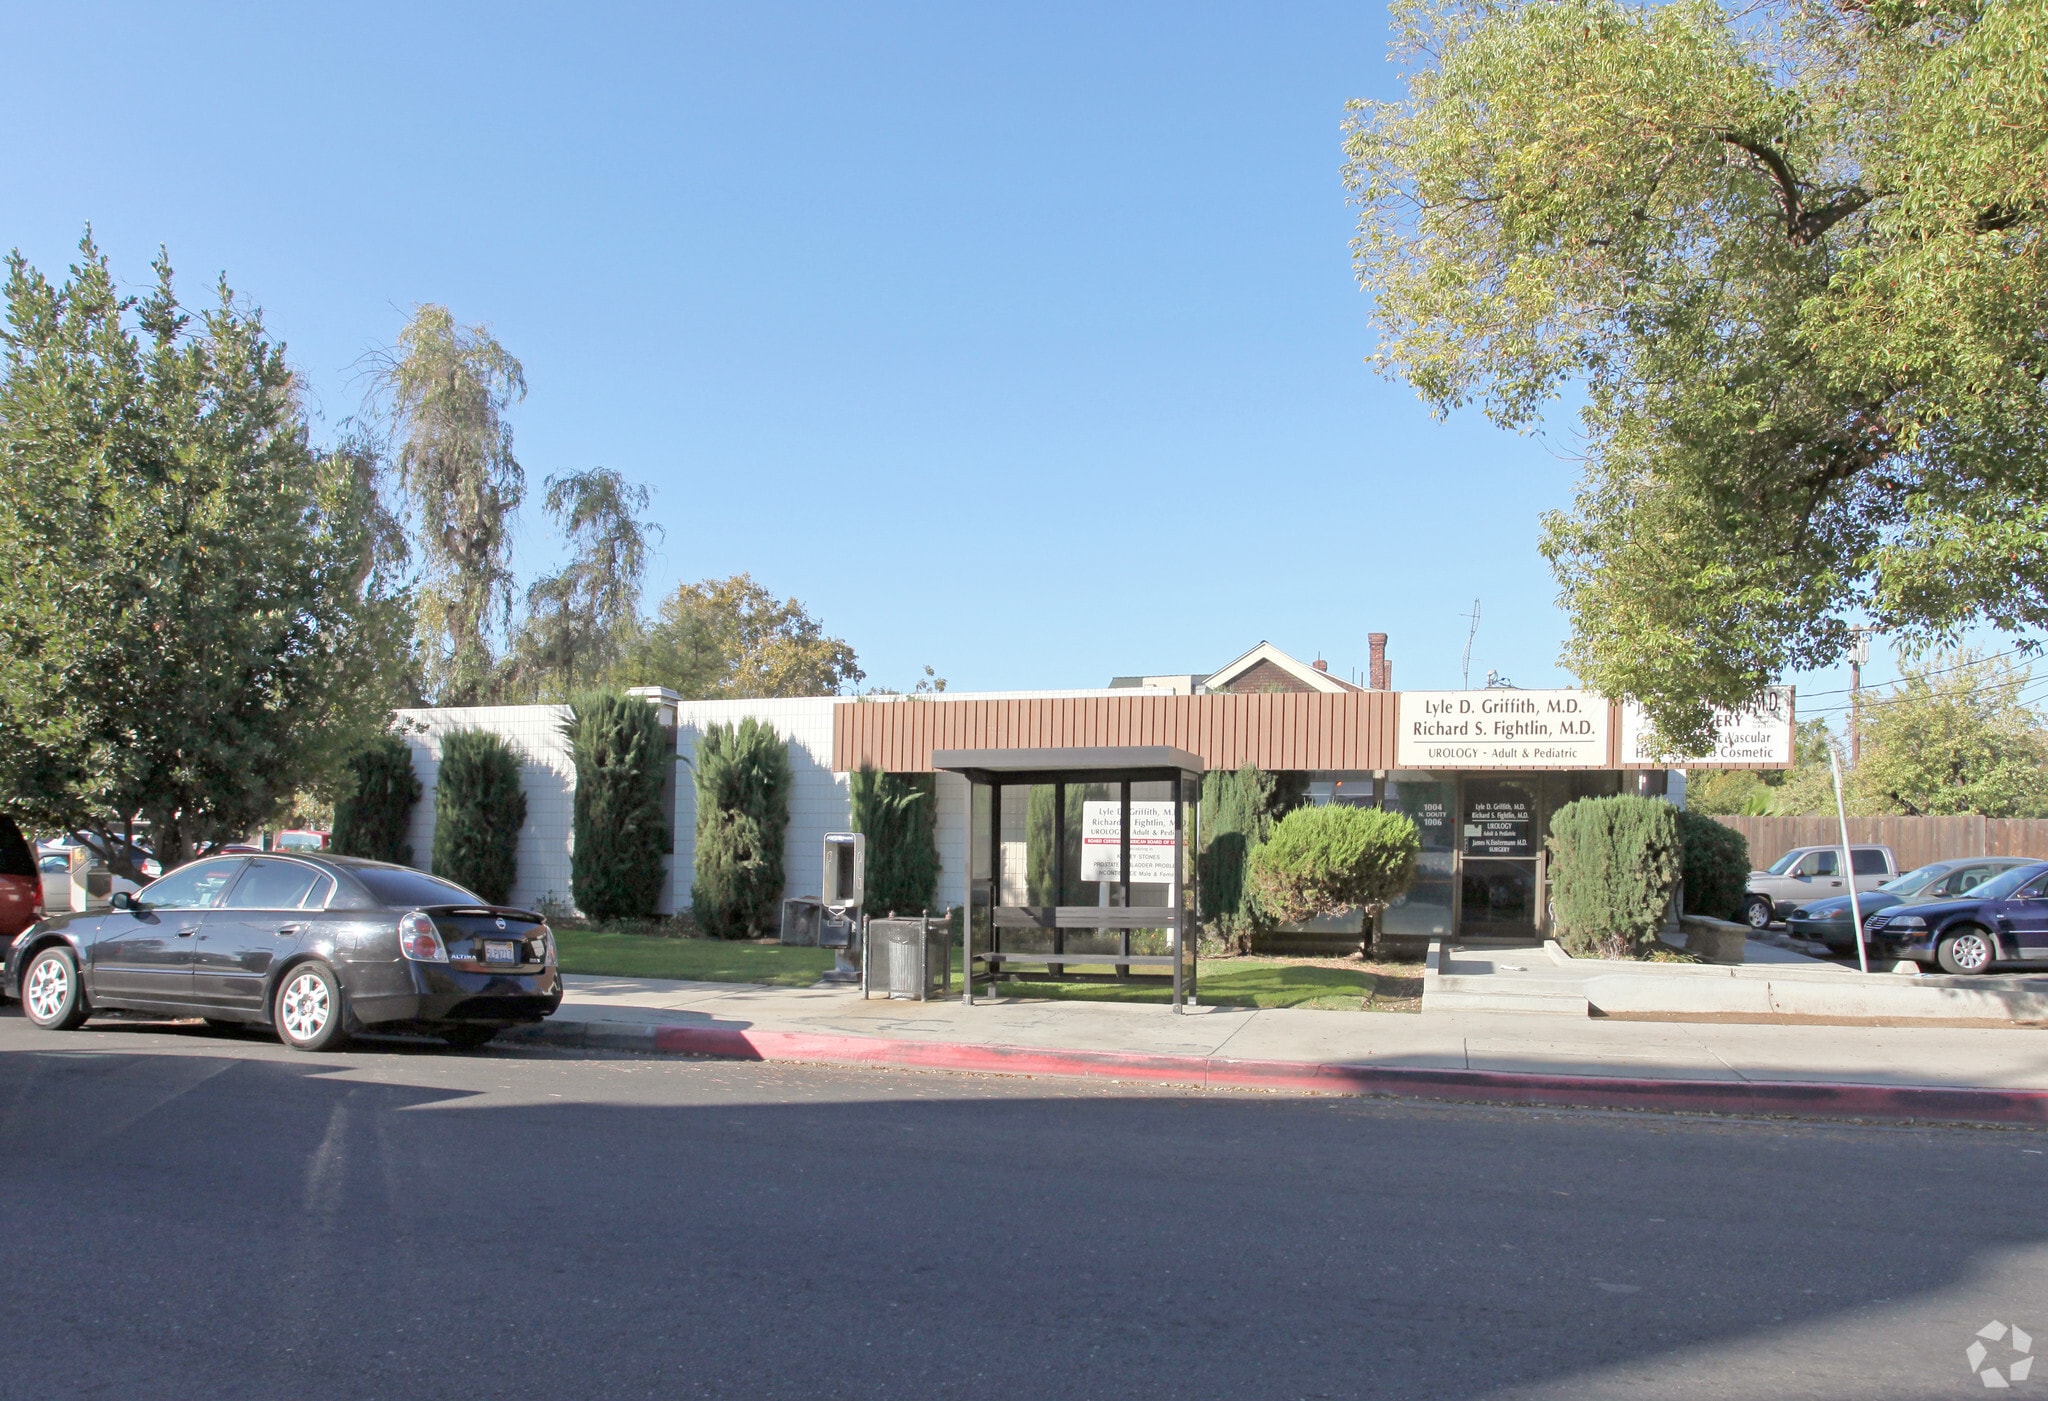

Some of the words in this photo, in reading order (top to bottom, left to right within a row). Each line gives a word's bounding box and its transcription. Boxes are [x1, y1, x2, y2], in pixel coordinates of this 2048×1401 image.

[1425, 699, 1453, 718] Lyle
[1459, 699, 1475, 714] D.
[1481, 698, 1540, 717] Griffith,
[1547, 698, 1582, 713] M.D.
[1413, 720, 1468, 736] Richard
[1475, 721, 1487, 736] S.
[1494, 720, 1553, 740] Fightlin,
[1559, 720, 1595, 736] M.D.
[1727, 732, 1771, 744] Vascular
[1428, 748, 1478, 759] UROLOGY
[1492, 747, 1518, 759] Adult
[1521, 748, 1530, 759] &
[1534, 747, 1578, 759] Pediatric
[1720, 745, 1774, 758] Cosmetic
[1424, 803, 1442, 811] 1004
[1475, 803, 1486, 811] Lyle
[1493, 803, 1512, 811] Griffith,
[1099, 807, 1114, 816] Lyle
[1130, 807, 1160, 817] Griffith,
[1471, 811, 1490, 819] Richard
[1517, 811, 1529, 819] M.D.
[1134, 818, 1166, 828] Fightlin,
[1424, 818, 1443, 826] 1006
[1487, 822, 1512, 830] UROLOGY
[1091, 828, 1121, 836] UROLOG
[1516, 838, 1528, 846] M.D.
